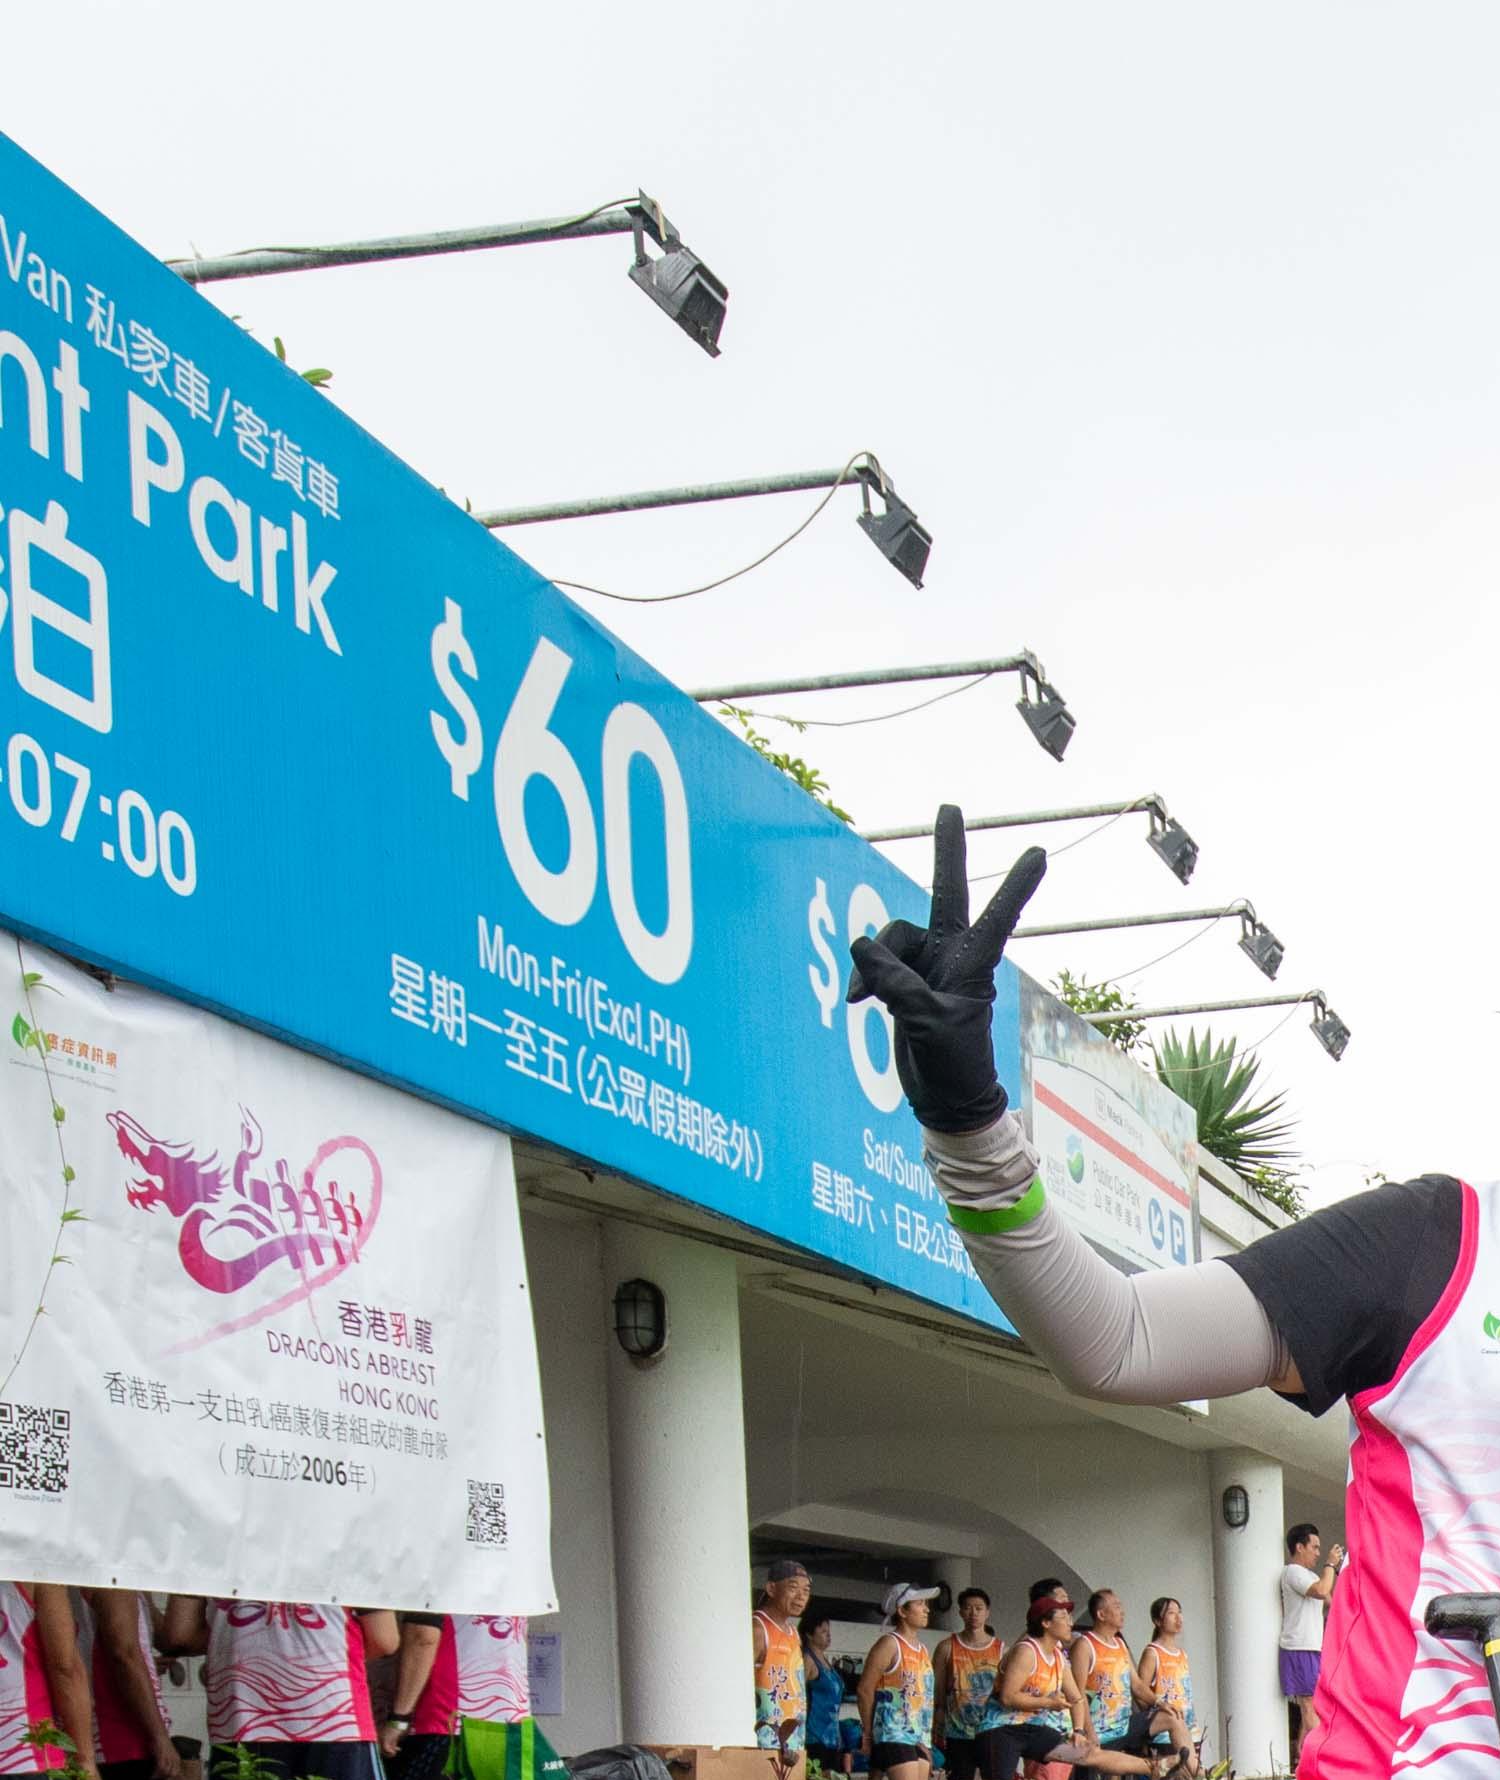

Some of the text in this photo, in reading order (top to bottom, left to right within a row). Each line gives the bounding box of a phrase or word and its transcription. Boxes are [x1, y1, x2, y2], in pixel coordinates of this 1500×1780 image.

[85, 282, 342, 521] 私家車/客貨車
[127, 389, 344, 656] Park
[430, 596, 694, 985] $60
[389, 952, 764, 1184] 星期一至五(公眾假期除外)
[477, 913, 692, 1087] Mon-Fri(Excl.PH)
[808, 876, 905, 1114] $8
[811, 1160, 981, 1281] 星期六、日及公眾
[266, 1329, 436, 1387] DRAGONS ABREAST
[337, 1299, 434, 1355] 香港乳龍
[338, 1379, 439, 1421] HONG KONG
